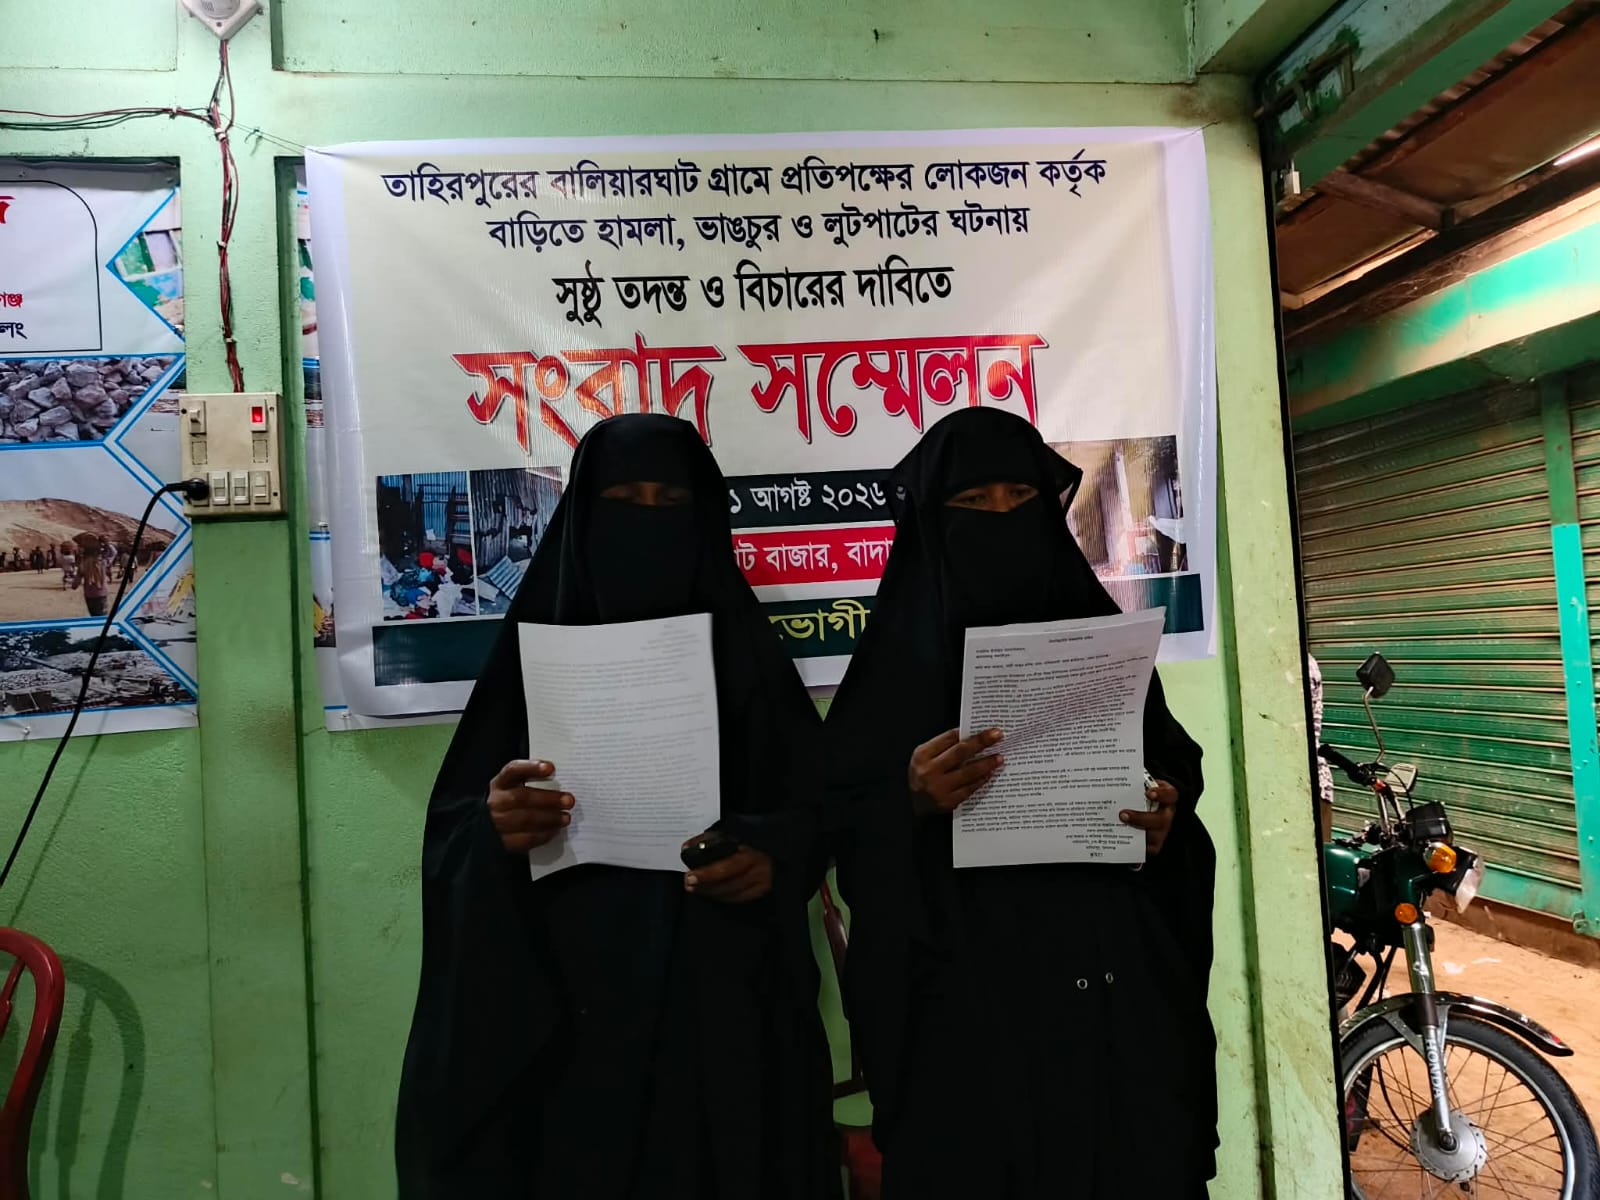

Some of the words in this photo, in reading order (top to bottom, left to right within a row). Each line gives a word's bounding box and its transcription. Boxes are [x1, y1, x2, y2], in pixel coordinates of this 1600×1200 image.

[381, 163, 539, 209] তাহিরপুরের
[547, 159, 702, 201] বালিয়ারঘাট
[708, 161, 770, 196] গ্রামে
[780, 156, 914, 192] প্রতিপক্ষের
[925, 159, 1029, 190] লোকজন
[1036, 149, 1107, 198] কর্তৃক
[487, 211, 584, 253] বাড়িতে
[597, 214, 685, 251] হামলা,
[694, 213, 780, 251] ভাঙচুর
[791, 215, 813, 240] ও
[821, 203, 938, 248] লুটপাটের
[947, 200, 1030, 237] ঘটনায়
[551, 260, 604, 328] সুষ্ঠু
[612, 275, 690, 313] তদন্ত
[699, 275, 724, 309] ও
[733, 259, 847, 312] বিচারের
[853, 254, 954, 307] দাবিতে
[450, 332, 726, 456] সংবাদ
[738, 334, 1050, 445] সম্মেলন
[750, 477, 812, 512] আগষ্ট
[822, 481, 887, 512] ২০২৬
[763, 540, 839, 574] বাজার,
[1425, 1039, 1445, 1098] HONDA
